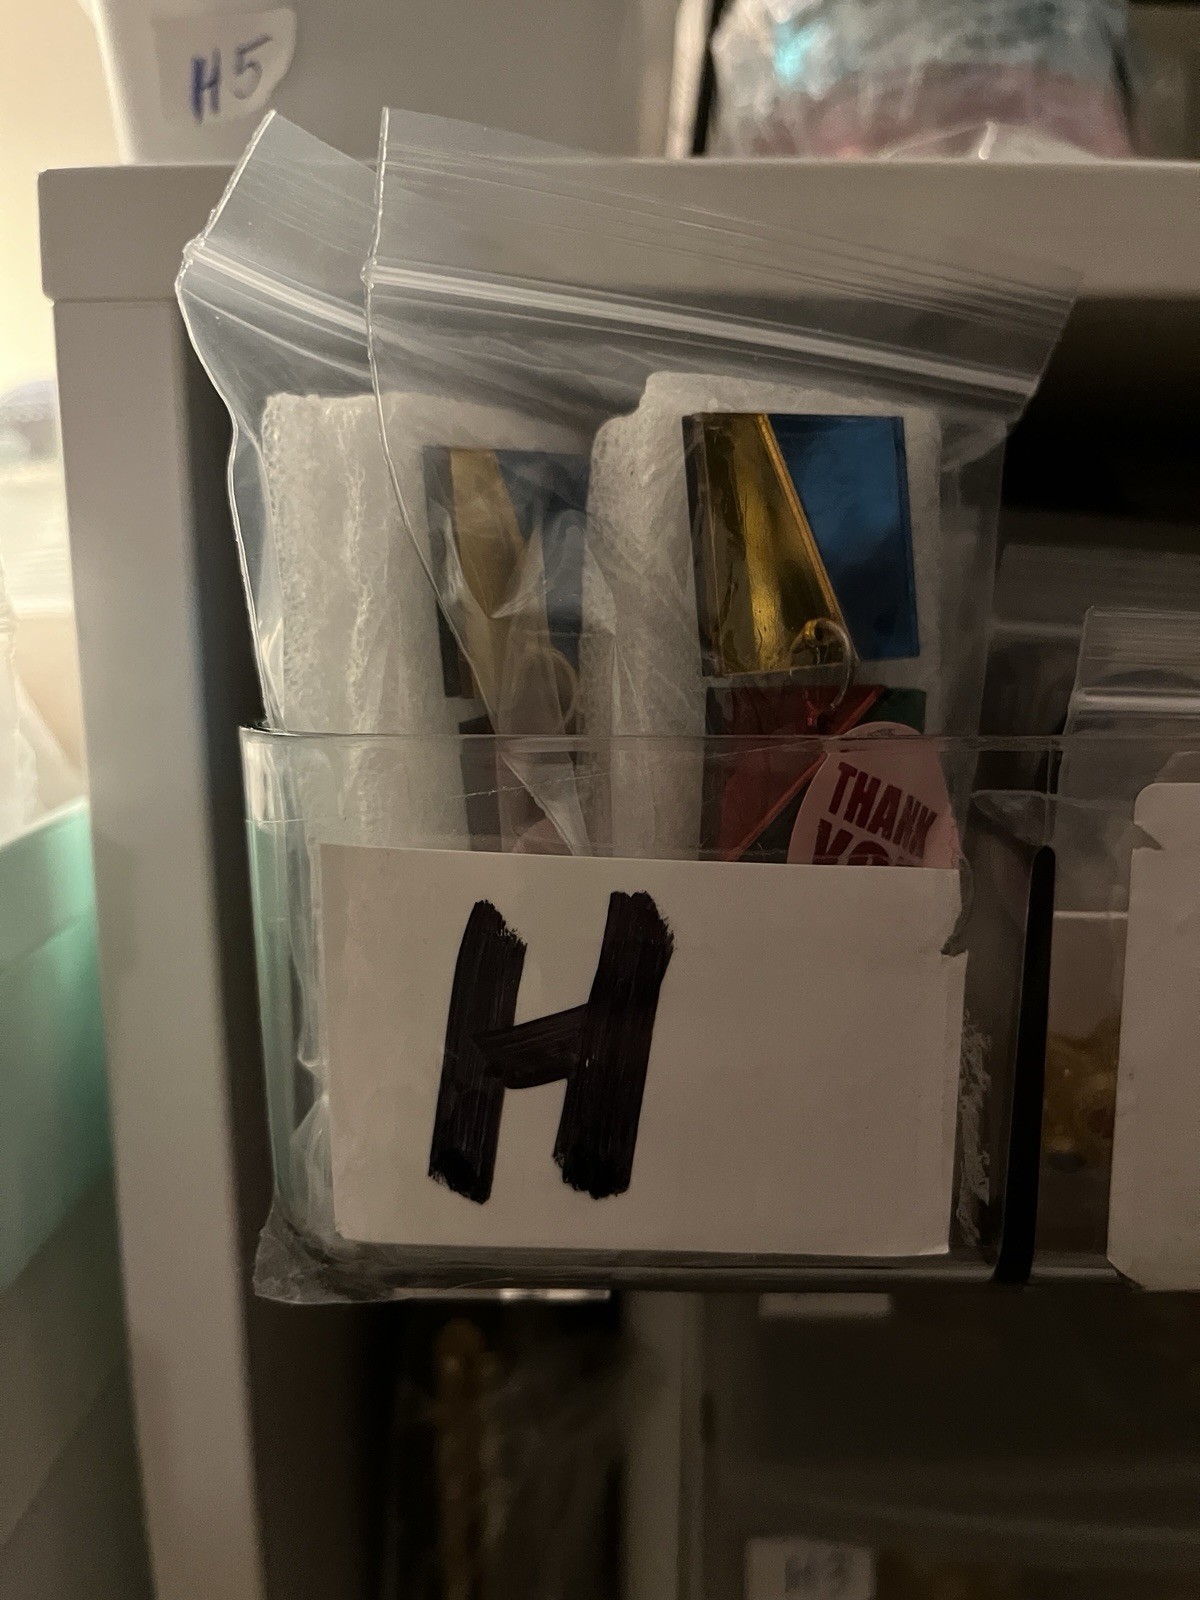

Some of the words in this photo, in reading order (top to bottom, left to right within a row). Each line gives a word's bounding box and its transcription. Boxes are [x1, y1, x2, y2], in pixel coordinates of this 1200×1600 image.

[191, 34, 272, 124] H5
[828, 761, 938, 859] THANK
[429, 891, 675, 1204] H
